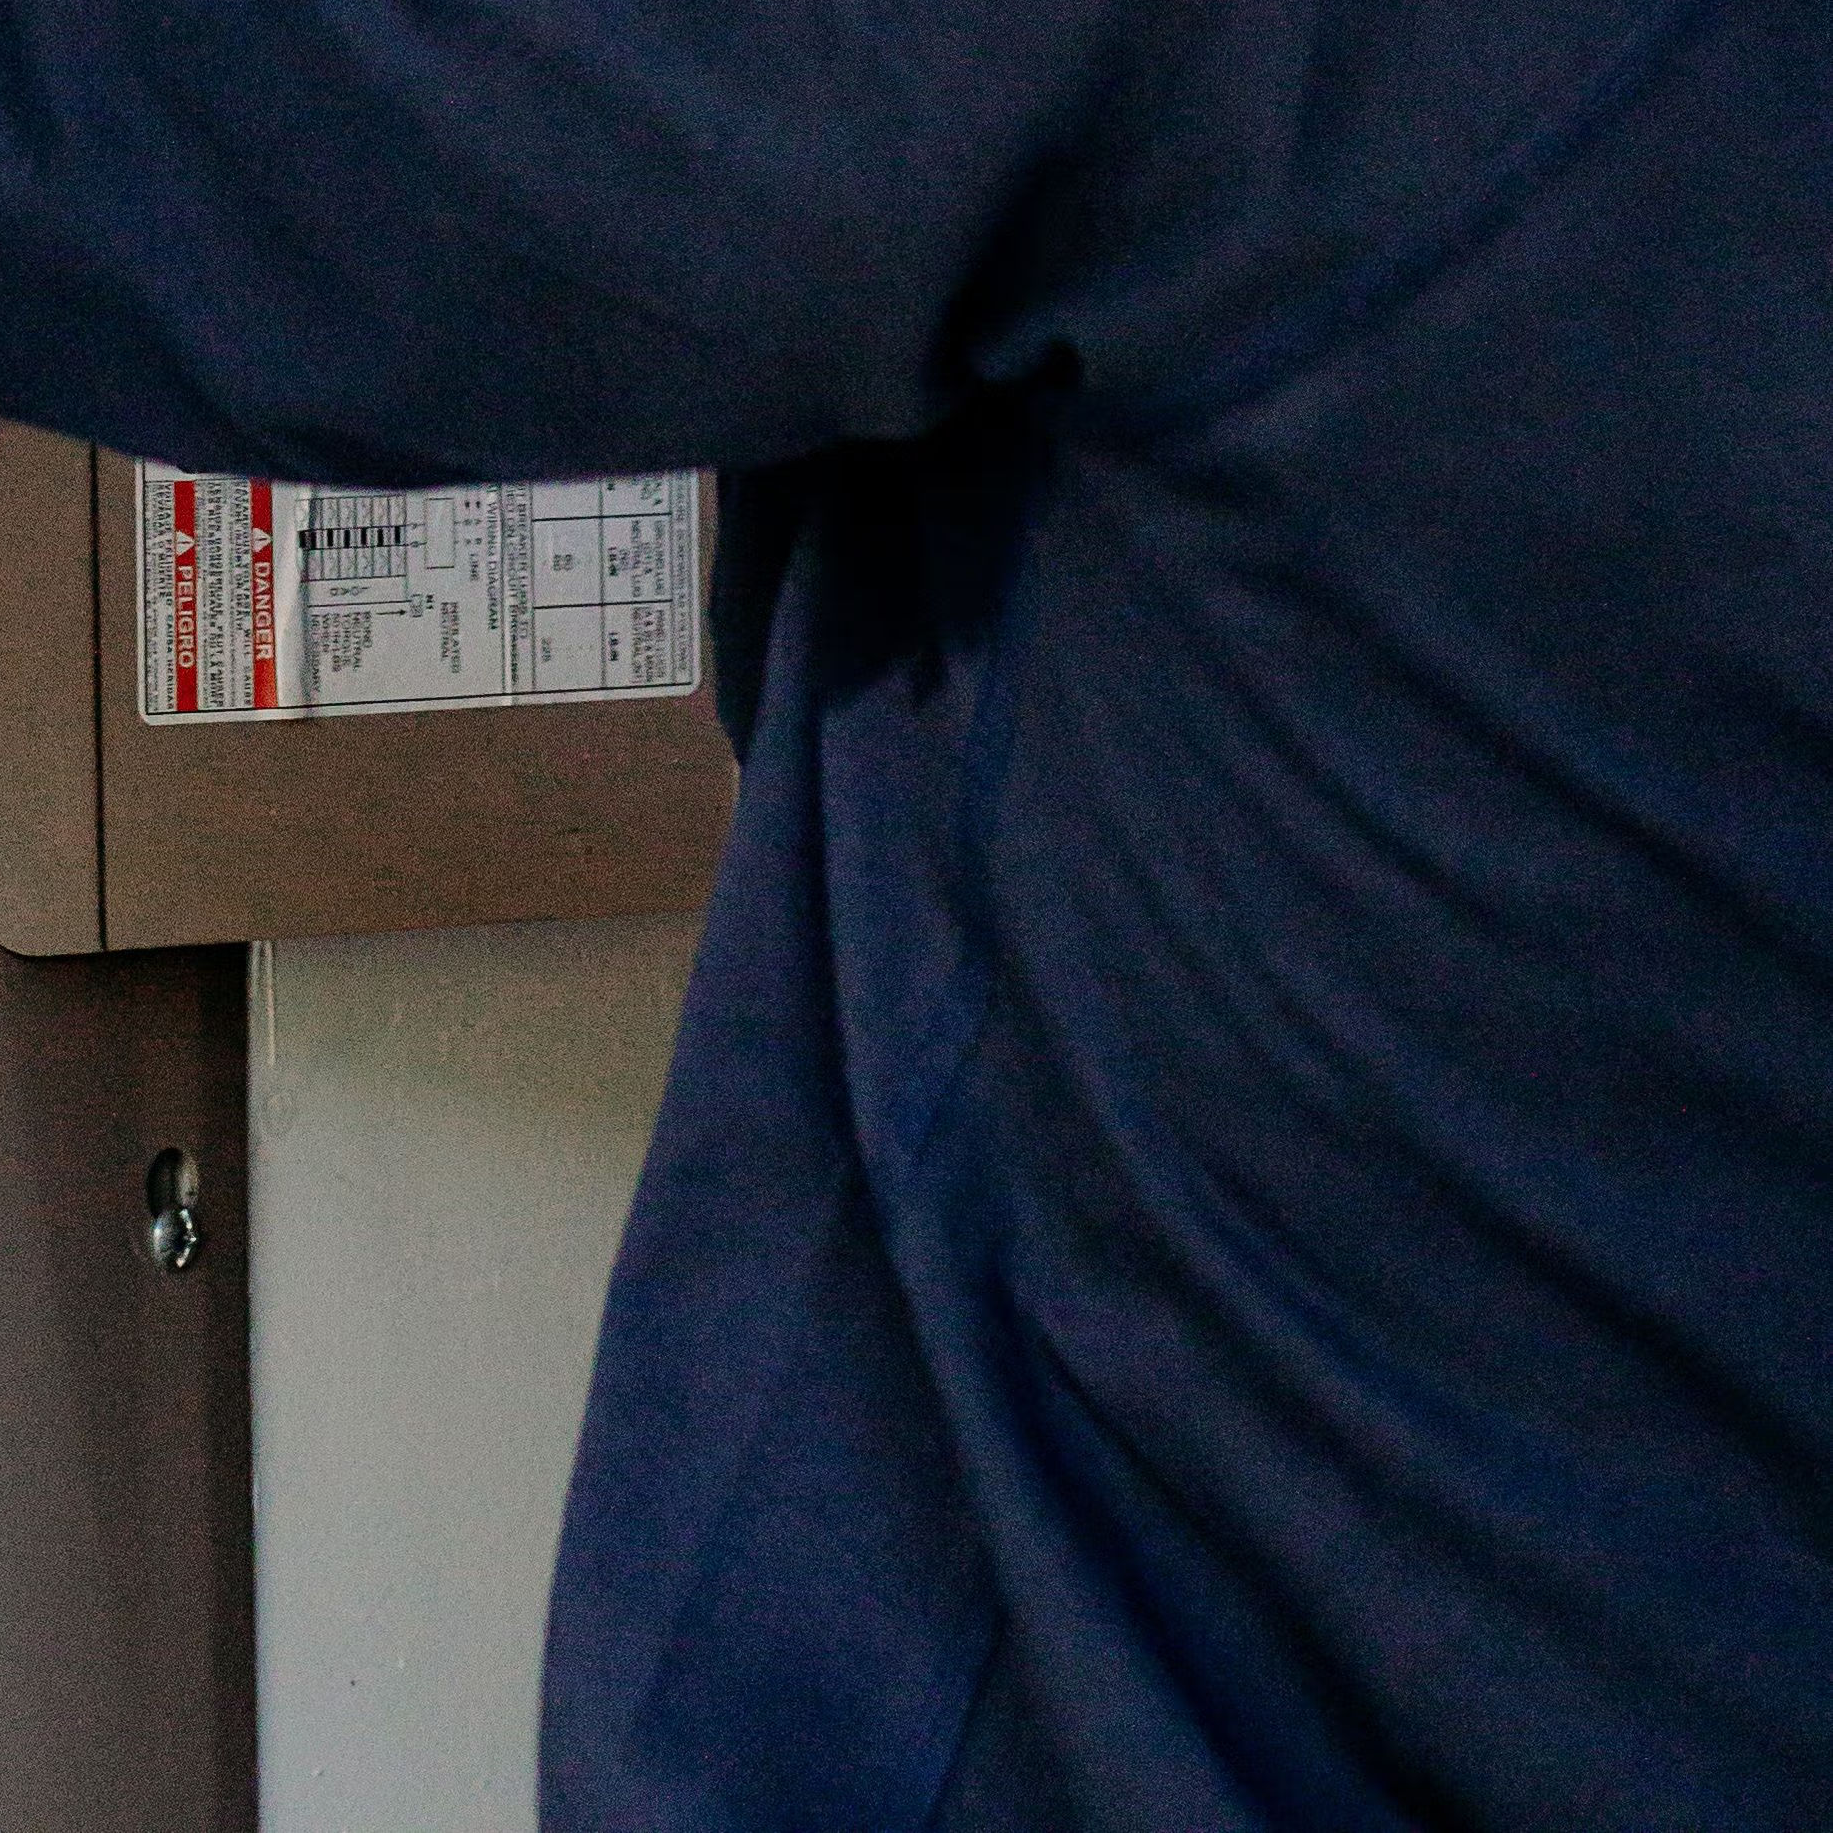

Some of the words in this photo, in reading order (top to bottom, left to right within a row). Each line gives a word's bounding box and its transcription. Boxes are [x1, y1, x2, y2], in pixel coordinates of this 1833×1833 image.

[178, 566, 194, 669] PELIGRO
[255, 562, 272, 660] DANGER
[488, 561, 498, 629] DIAGRAM
